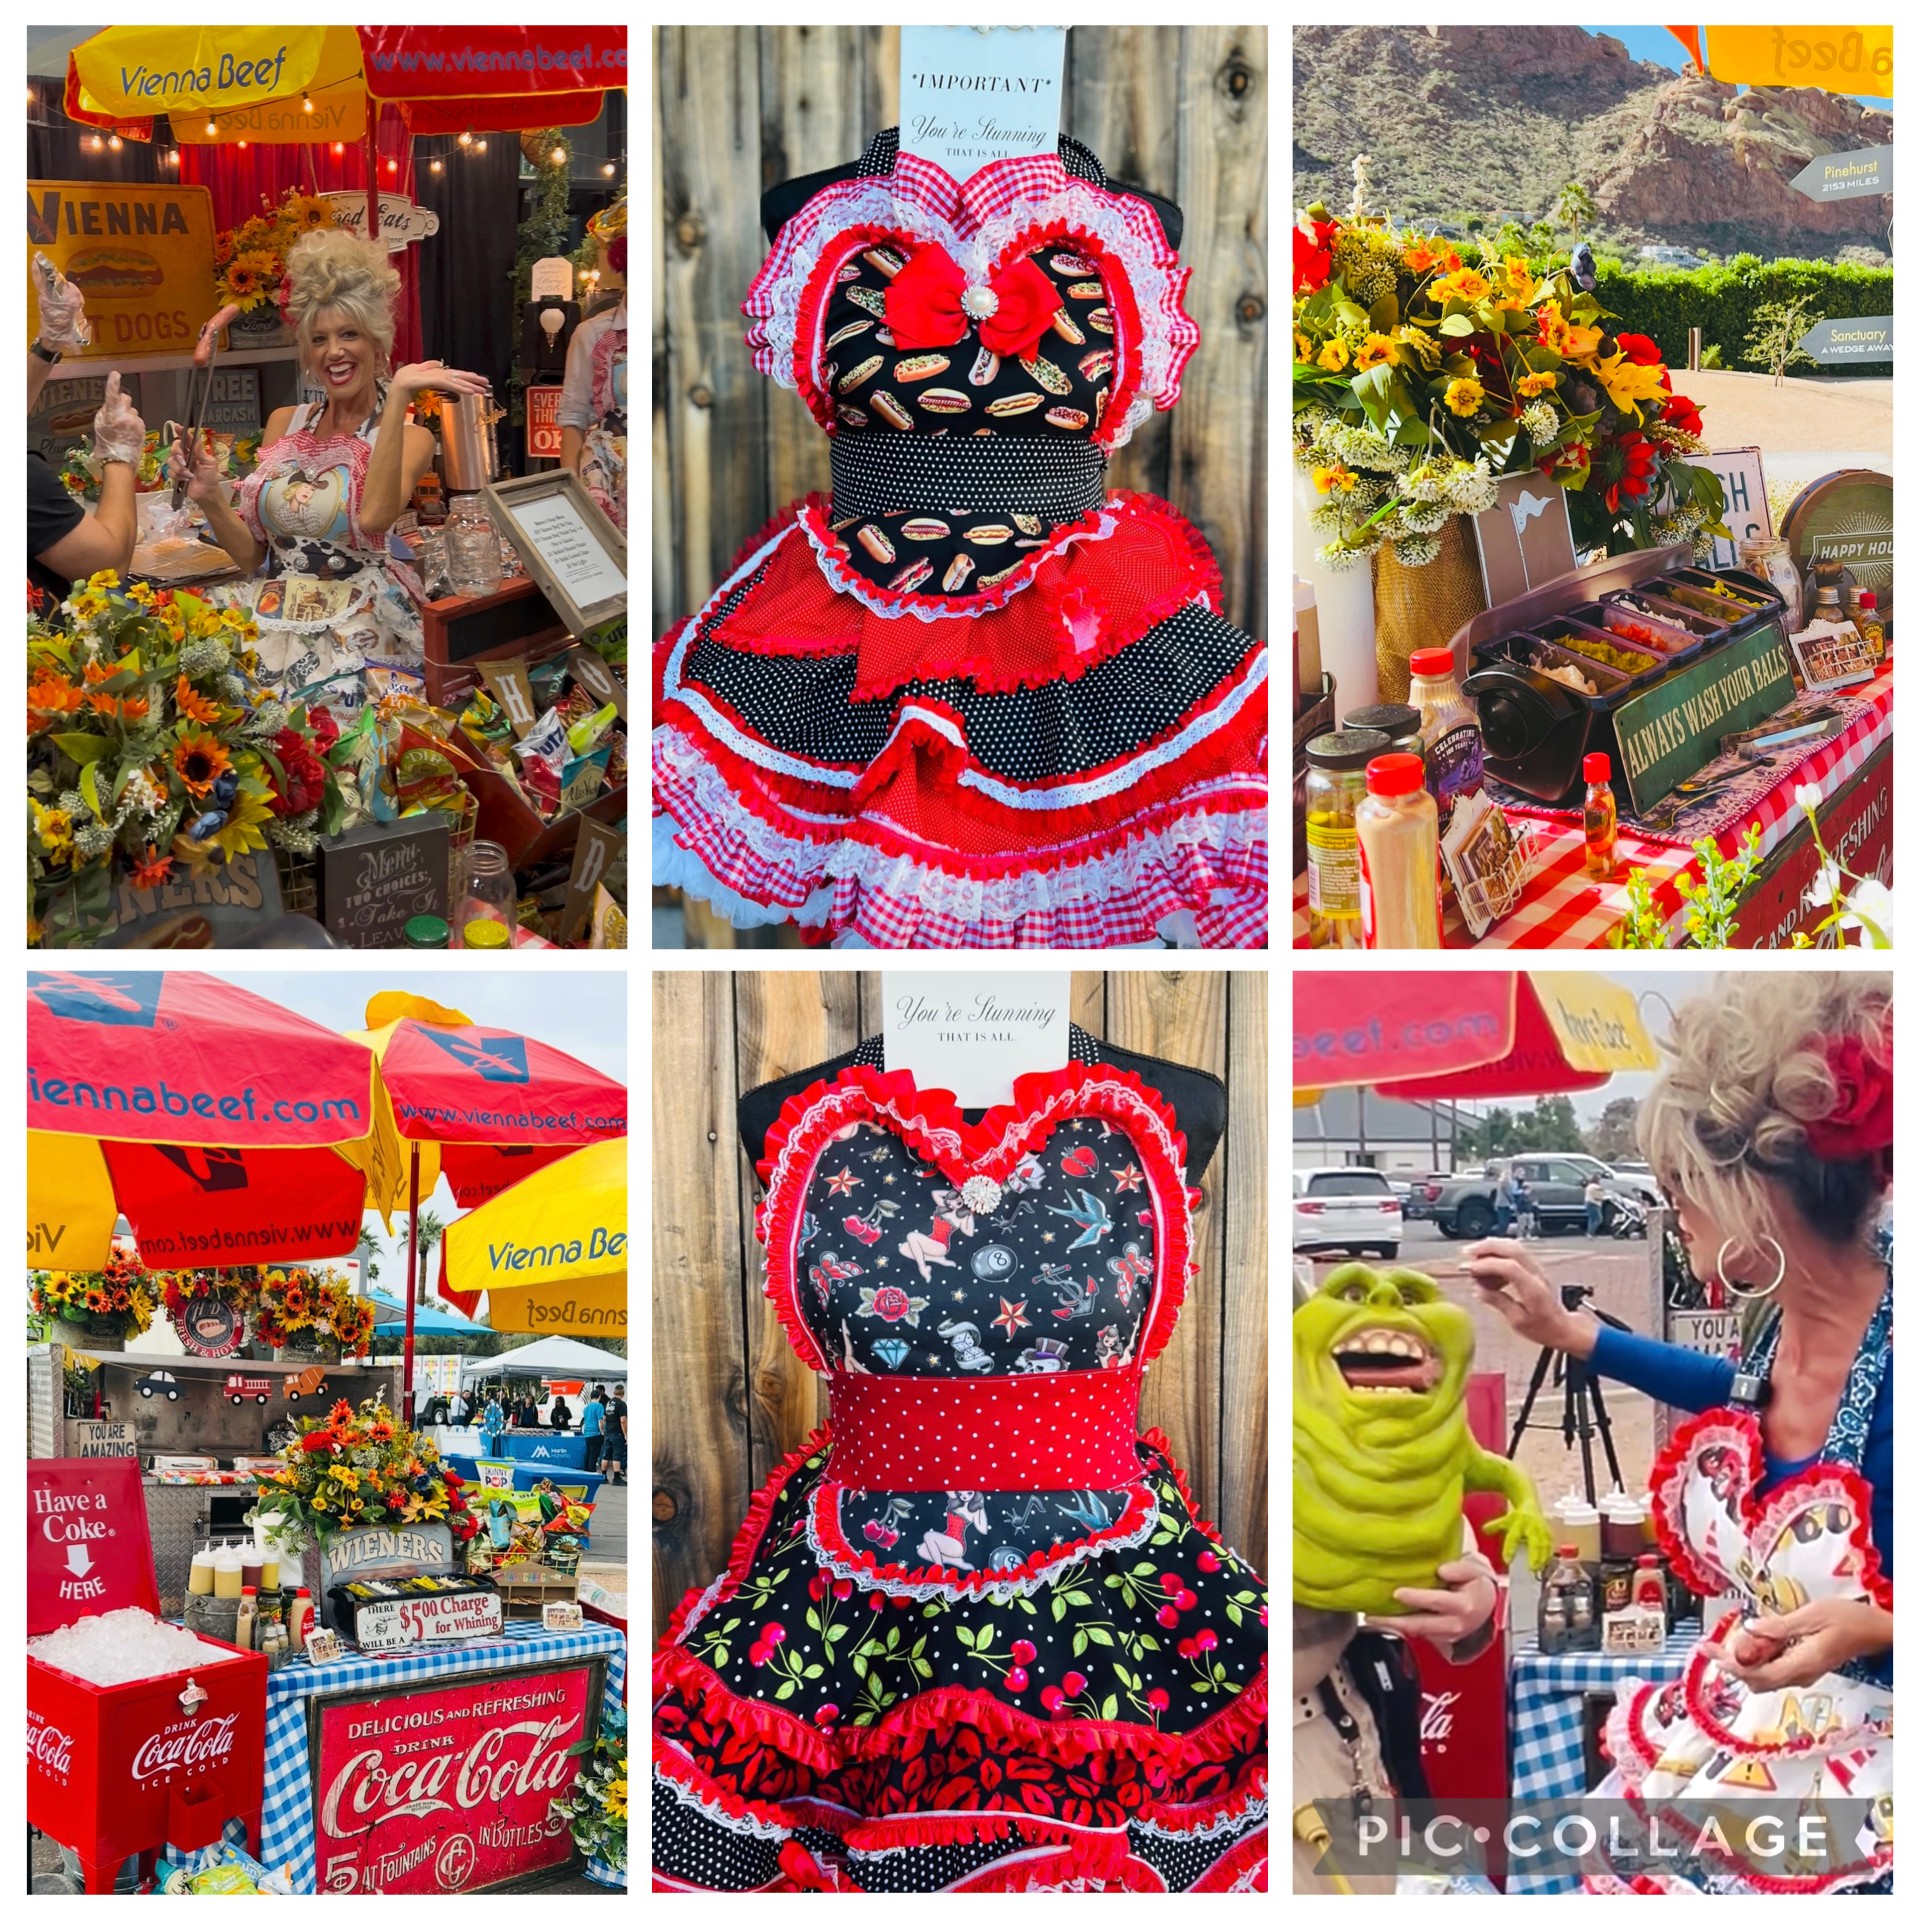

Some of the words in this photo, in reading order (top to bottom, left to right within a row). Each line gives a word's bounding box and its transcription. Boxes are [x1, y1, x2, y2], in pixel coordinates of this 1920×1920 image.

[121, 65, 211, 97] Vienna
[218, 46, 287, 92] Beef
[911, 114, 968, 145] You're
[971, 115, 1048, 149] Stunning
[945, 147, 975, 157] THAT
[977, 148, 988, 158] IS
[1824, 160, 1878, 180] Pinehurst
[1822, 181, 1846, 192] 2153
[1846, 176, 1880, 190] MILES
[27, 191, 190, 245] VIENNA
[377, 203, 412, 231] Eats
[114, 310, 191, 342] DOGS
[1830, 328, 1887, 344] Sanctuary
[1821, 346, 1829, 354] A
[1829, 344, 1866, 354] WEDGE
[534, 393, 562, 408] EVER
[203, 407, 256, 423] ARCASM
[1820, 543, 1865, 560] HAPPY
[495, 674, 533, 724] H
[1625, 707, 1686, 779] ALWAYS
[1681, 683, 1724, 737] WASH
[1718, 665, 1756, 712] YOUR
[1750, 644, 1788, 692] BALLS
[1434, 729, 1475, 756] CELEBRATING
[346, 891, 372, 909] TWO
[375, 870, 429, 898] CHOICES:
[354, 902, 407, 927] Take
[360, 927, 405, 948] LEAV
[896, 995, 963, 1031] You're
[967, 993, 1056, 1030] Stunning
[937, 1032, 971, 1042] THAT
[975, 1032, 987, 1042] IS
[399, 1103, 627, 1131] www.viennabeef.com
[488, 1240, 583, 1271] Vienna
[588, 1227, 627, 1260] Be
[176, 1318, 199, 1353] FRESH
[200, 1348, 209, 1357] &
[212, 1342, 236, 1358] HOT
[1691, 1318, 1726, 1340] YOU
[88, 1425, 106, 1441] YOU
[106, 1424, 125, 1440] ARE
[81, 1441, 135, 1458] AMAZING
[484, 1467, 507, 1477] SKINNY
[33, 1489, 91, 1513] Have
[95, 1493, 107, 1509] a
[329, 1531, 443, 1574] WIENERS
[59, 1576, 106, 1600] HERE
[367, 1603, 396, 1614] THERE
[441, 1595, 489, 1616] Charge
[436, 1620, 451, 1634] for
[454, 1615, 498, 1631] Whining
[362, 1639, 386, 1650] WILL
[386, 1637, 398, 1646] BE
[398, 1637, 405, 1645] A
[27, 1709, 45, 1725] RINK
[348, 1708, 445, 1740] DELICIOUS
[446, 1708, 471, 1720] AND
[472, 1688, 567, 1718] REFRESHING
[164, 1718, 198, 1735] DRINK
[131, 1711, 240, 1780] Coca-Cola
[393, 1735, 455, 1756] DRINK
[38, 1764, 68, 1786] COLD
[141, 1776, 171, 1792] ICE
[187, 1756, 229, 1777] COLD
[321, 1711, 581, 1840] Coca-Cola
[478, 1826, 490, 1846] IN
[490, 1818, 544, 1849] BOTTLES
[361, 1866, 379, 1892] AT
[376, 1835, 437, 1887] FOUNTAINS
